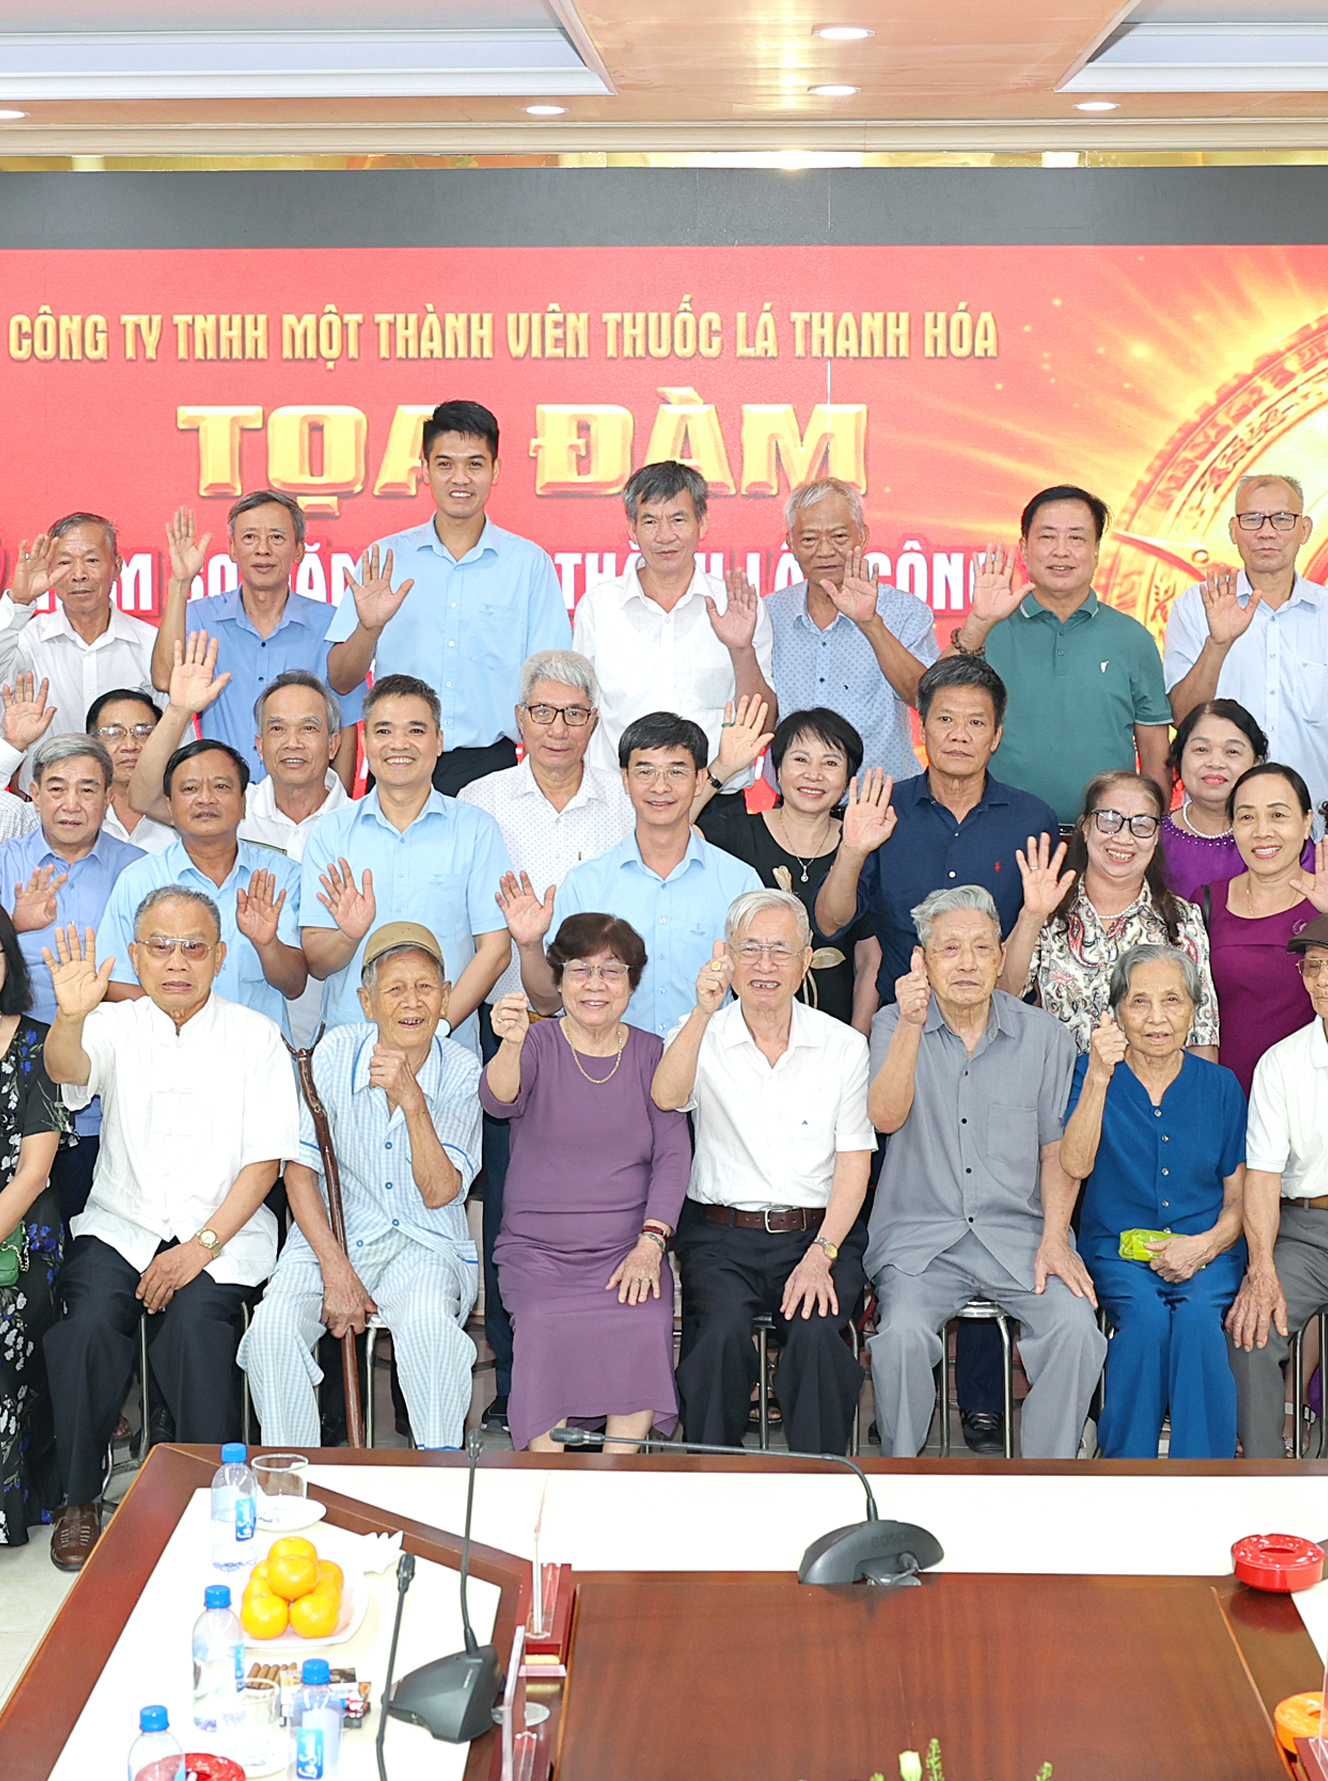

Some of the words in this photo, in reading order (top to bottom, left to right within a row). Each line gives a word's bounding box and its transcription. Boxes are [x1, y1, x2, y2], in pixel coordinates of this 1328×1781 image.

[9, 305, 108, 360] CÔNG
[121, 314, 162, 360] TY
[173, 314, 268, 360] TNHH
[282, 304, 363, 370] MỘT
[374, 304, 494, 359] THÀNH
[507, 303, 589, 358] VIÊN
[603, 295, 722, 358] THUỐC
[737, 302, 778, 358] LÁ
[791, 312, 910, 358] THANH
[924, 302, 998, 358] HÓA
[529, 386, 868, 497] ĐÀM
